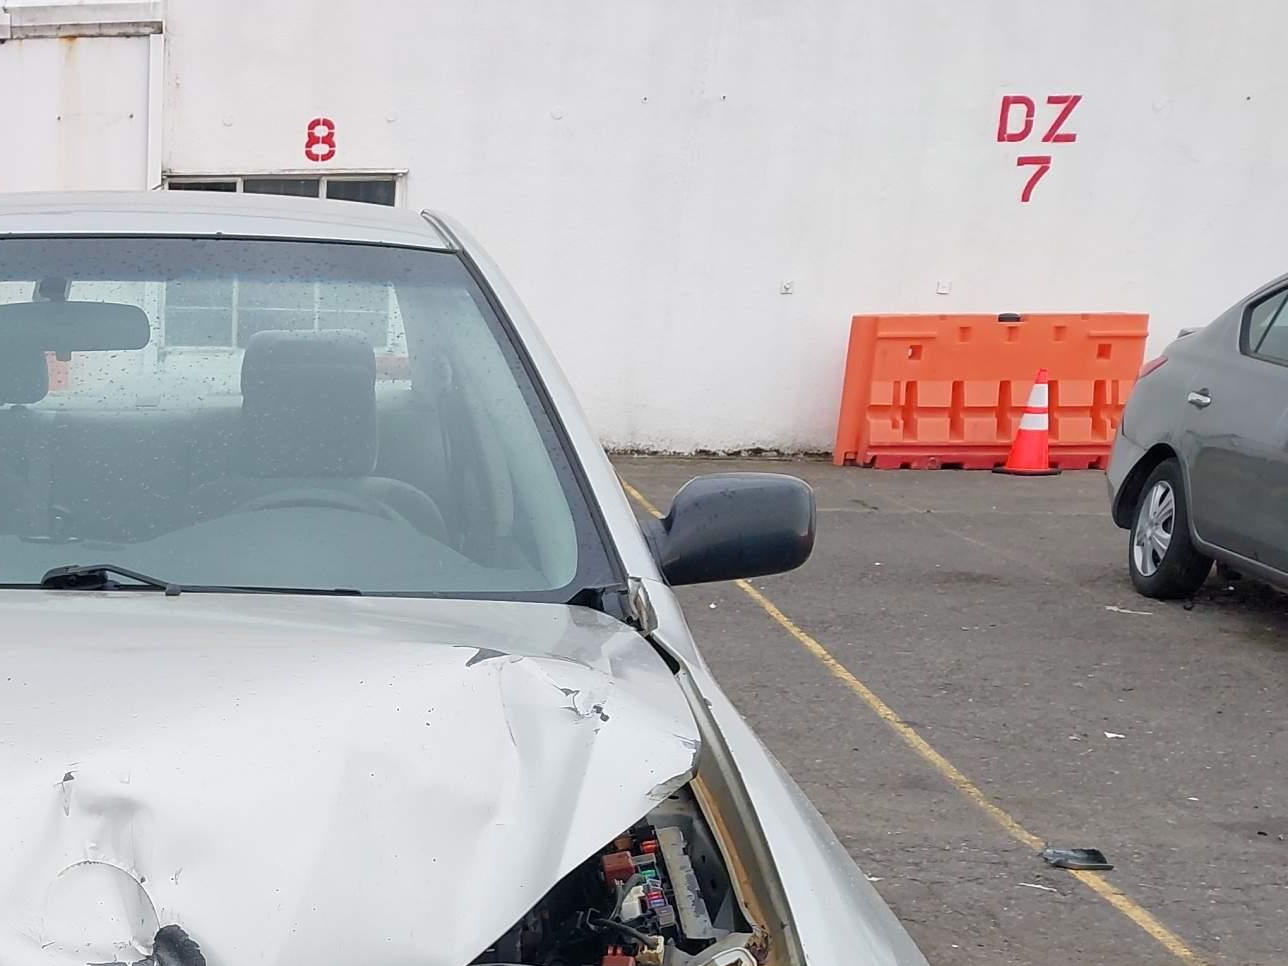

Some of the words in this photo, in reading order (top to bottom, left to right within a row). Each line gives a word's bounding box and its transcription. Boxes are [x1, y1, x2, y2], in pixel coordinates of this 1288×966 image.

[305, 118, 336, 162] 8
[996, 95, 1083, 142] DZ
[1016, 155, 1052, 202] 7
